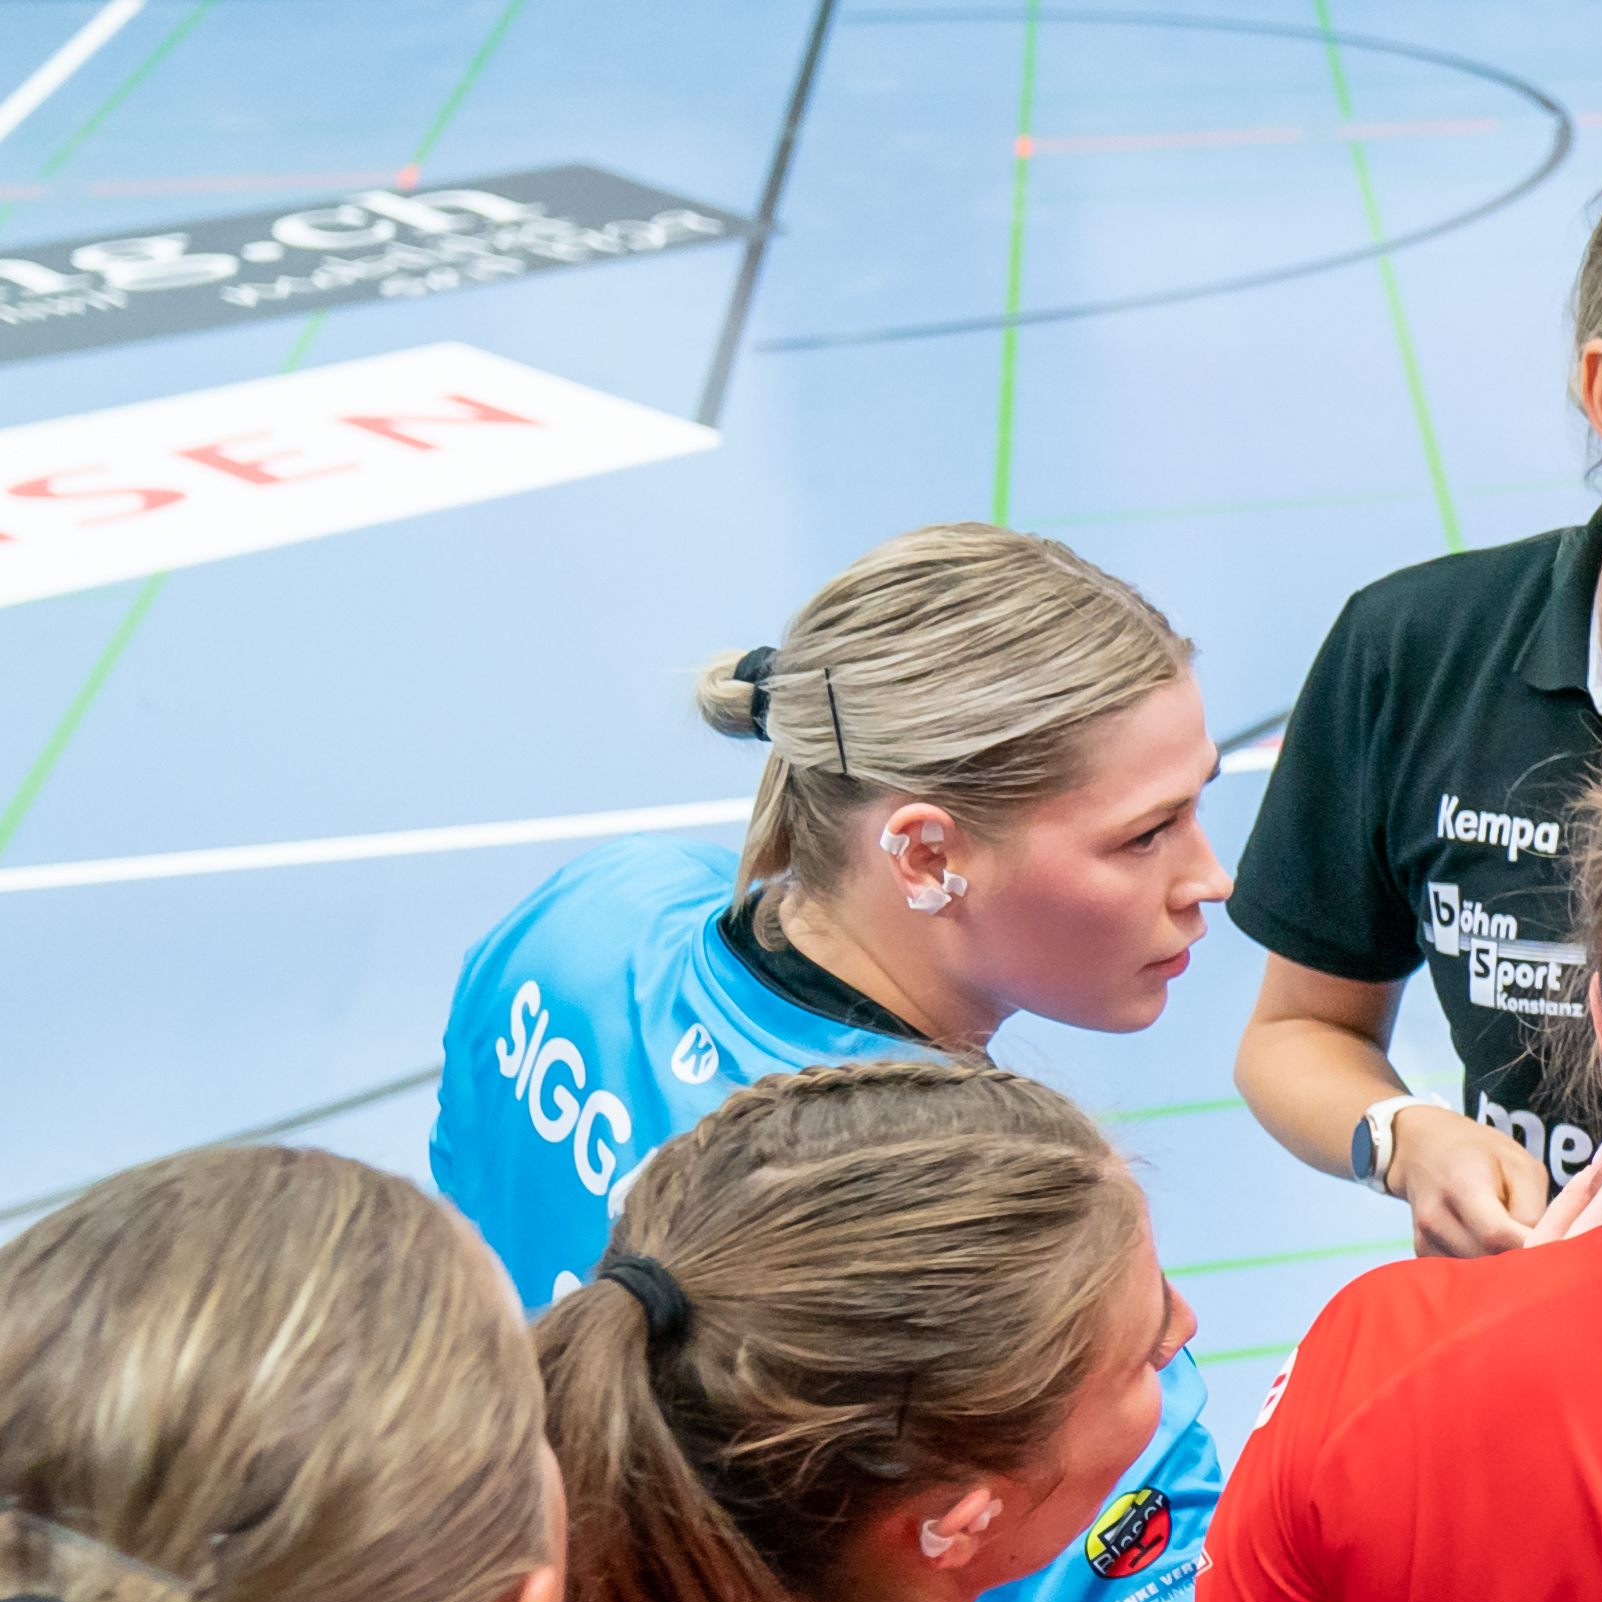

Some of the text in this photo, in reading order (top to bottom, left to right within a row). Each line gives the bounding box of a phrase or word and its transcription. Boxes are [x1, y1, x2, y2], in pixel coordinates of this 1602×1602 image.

[0, 394, 546, 546] SEN
[1436, 792, 1561, 863] Kempa
[495, 979, 659, 1220] SIGG
